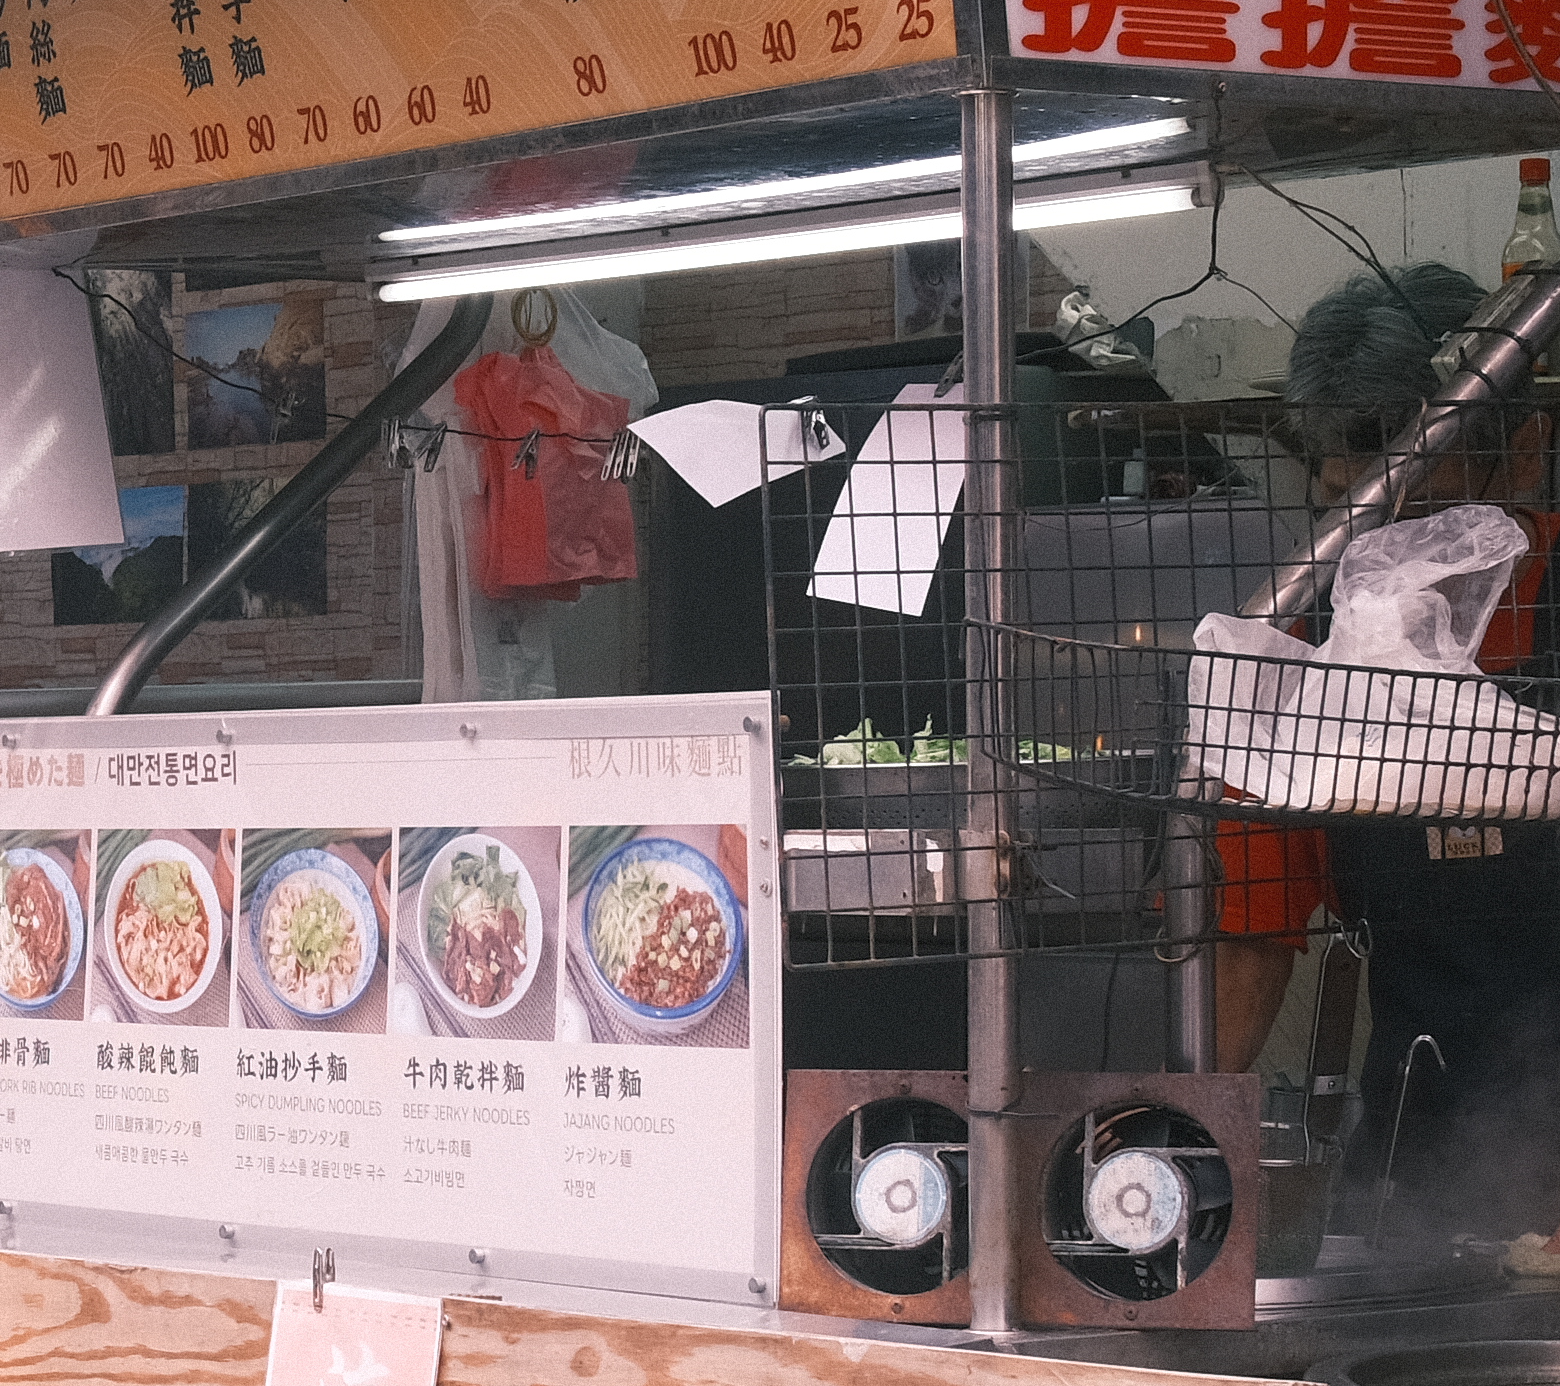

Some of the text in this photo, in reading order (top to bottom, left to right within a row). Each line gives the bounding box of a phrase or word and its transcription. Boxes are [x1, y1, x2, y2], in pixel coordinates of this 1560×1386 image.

[3, 160, 30, 196] 70
[49, 150, 78, 188] 70
[97, 142, 126, 179] 70
[148, 133, 175, 171] 40
[190, 123, 230, 164] 100
[247, 115, 276, 154] 80
[297, 104, 329, 144] 70
[353, 94, 382, 135] 60
[407, 85, 437, 126] 60
[462, 74, 492, 115] 40
[572, 54, 607, 97] 80
[688, 30, 737, 77] 100
[761, 19, 796, 64] 40
[825, 7, 863, 53] 25
[108, 750, 238, 787] 대만전통면요리
[96, 1040, 200, 1078] 酸辣餛飩麵
[236, 1047, 348, 1085] 紅油抄手麵
[22, 1080, 37, 1095] RIB
[39, 1081, 85, 1098] NOODLES
[403, 1056, 525, 1095] 牛肉乾拌麵
[563, 1064, 642, 1101] 炸醬麵
[95, 1084, 170, 1103] BEEF NOODLES
[235, 1093, 382, 1117] SPICY DUMPLING NOODLES
[403, 1103, 530, 1126] BEEF JERKY NOODLES
[563, 1112, 675, 1135] JAJANG NOODLES
[235, 1155, 253, 1171] 고추
[343, 1162, 361, 1180] 만두
[366, 1164, 386, 1182] 국수
[403, 1169, 465, 1189] 소고기비빔면
